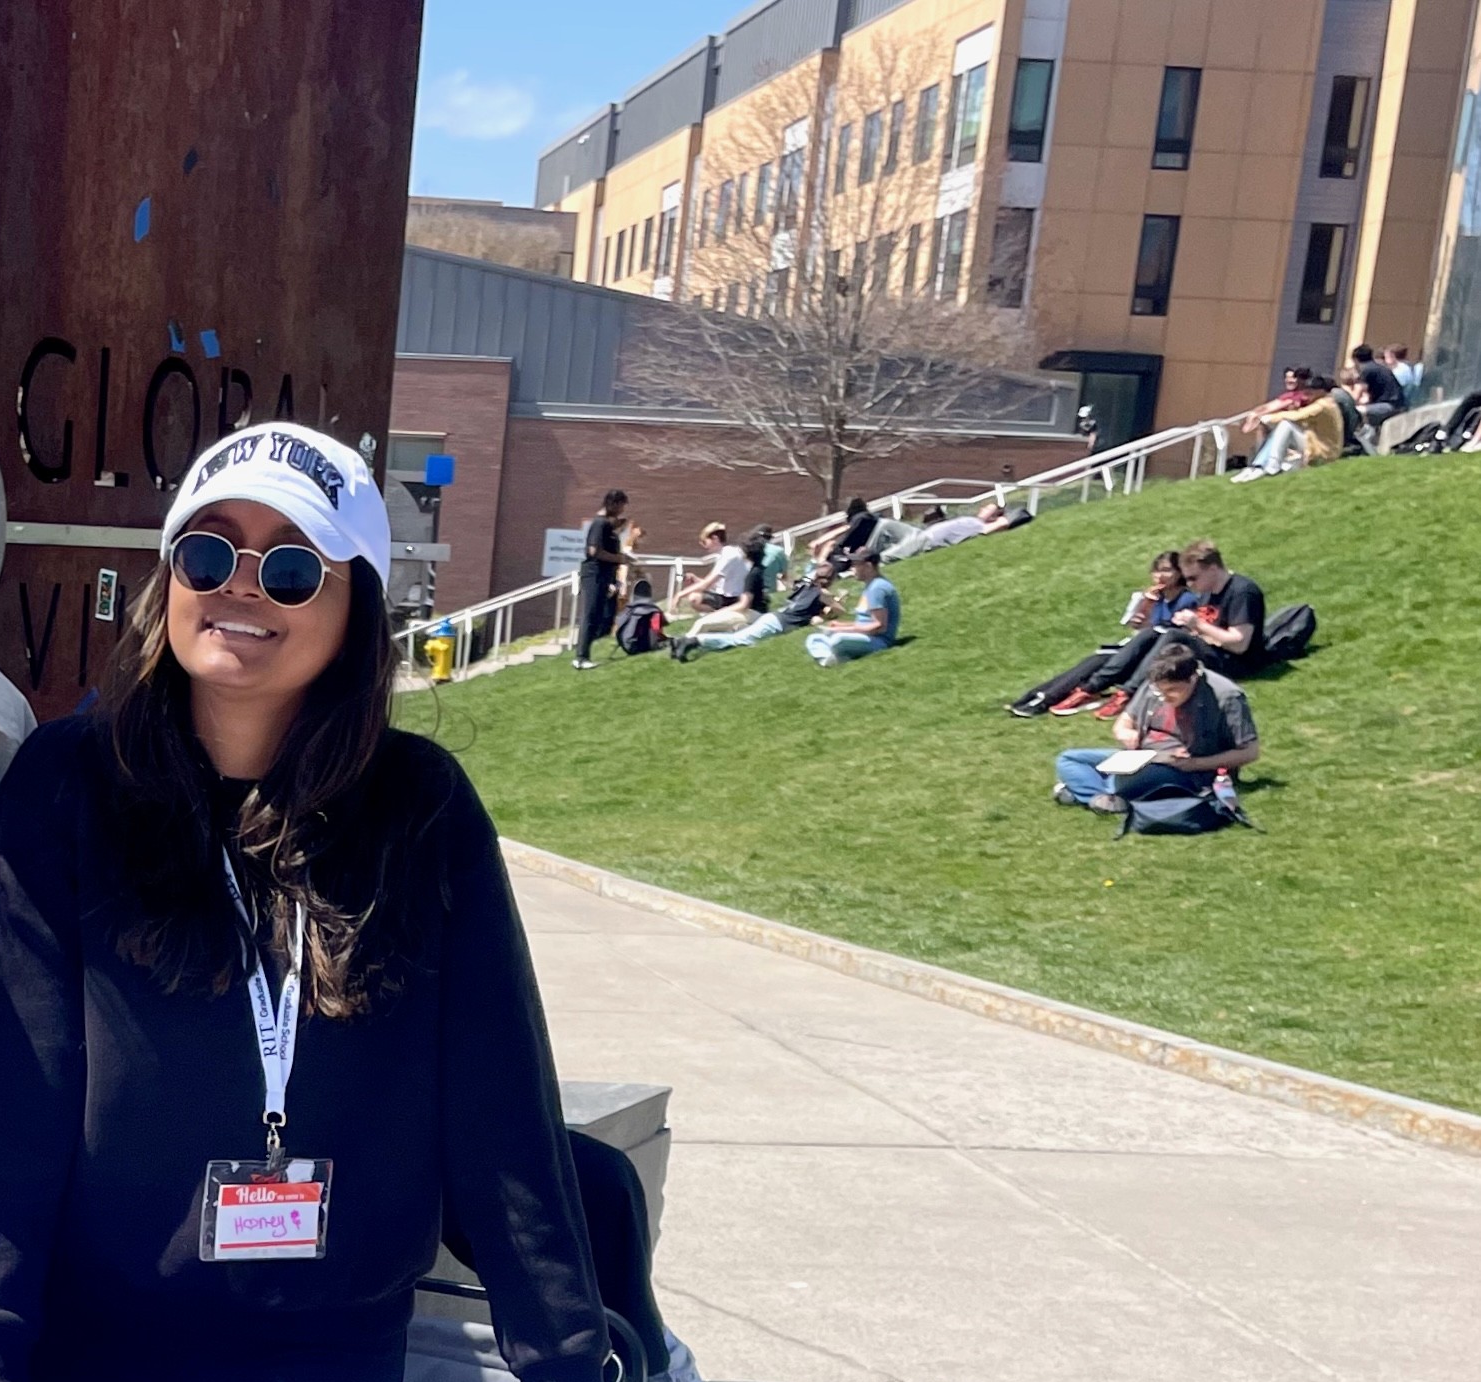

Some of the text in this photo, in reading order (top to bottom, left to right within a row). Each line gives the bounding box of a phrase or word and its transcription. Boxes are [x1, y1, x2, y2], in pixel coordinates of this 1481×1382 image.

[268, 431, 345, 511] YORK
[259, 1023, 278, 1058] RIT
[279, 985, 295, 1061] Graduate School
[235, 1186, 277, 1204] Hello
